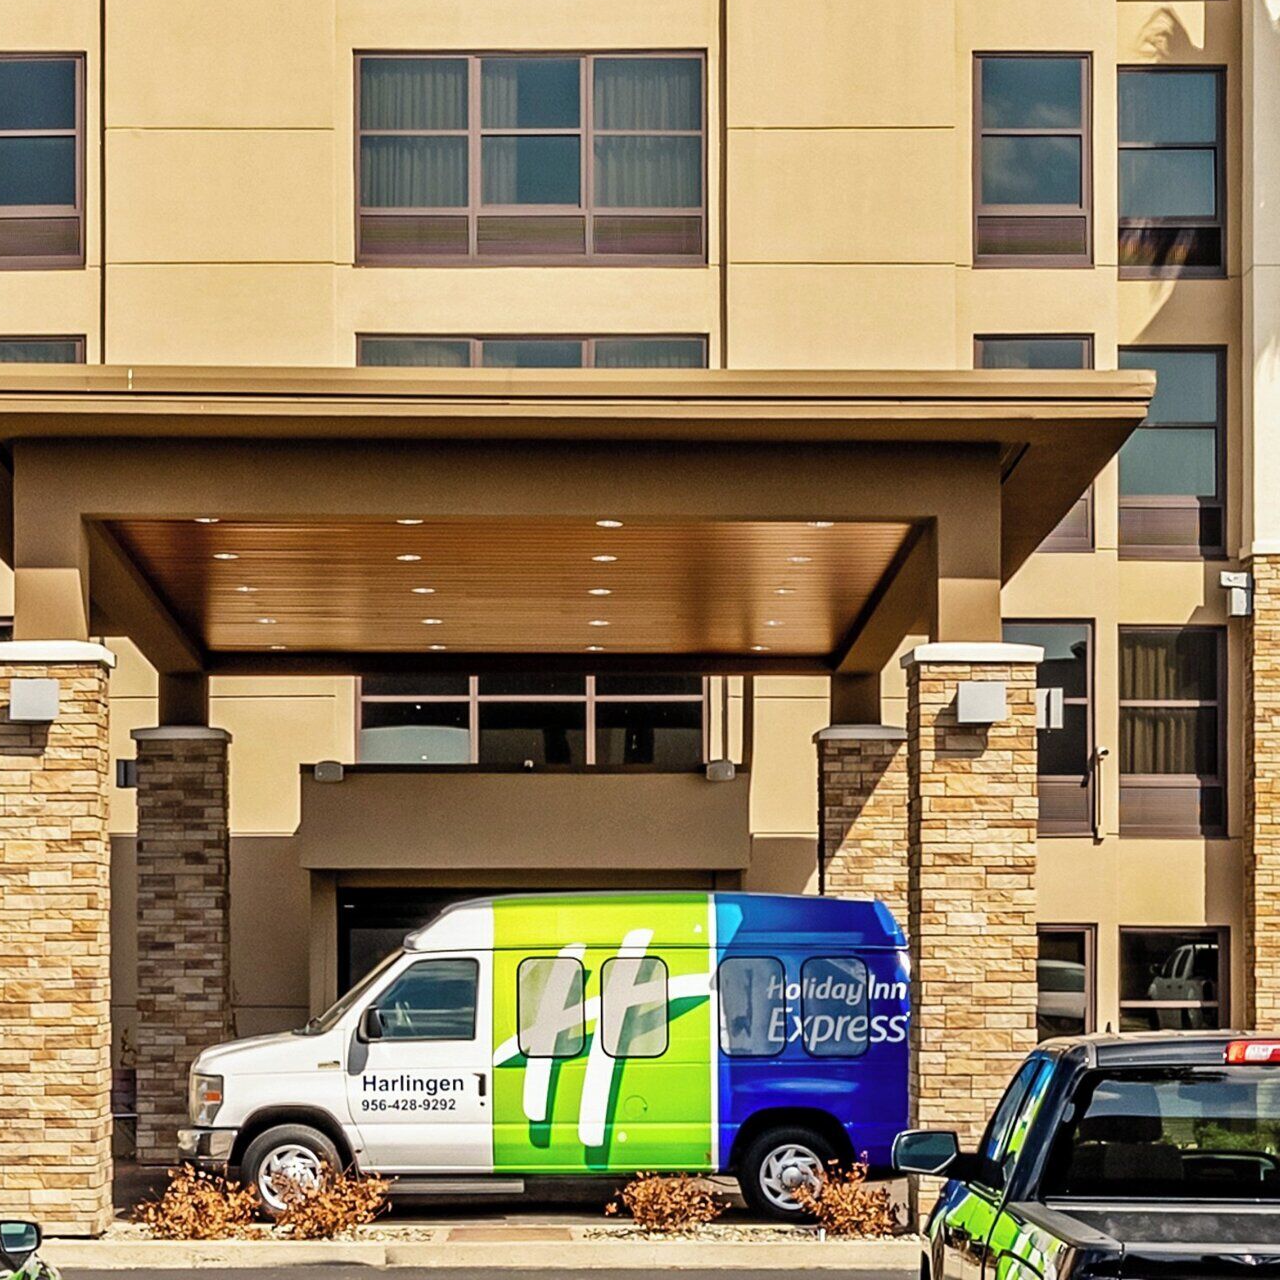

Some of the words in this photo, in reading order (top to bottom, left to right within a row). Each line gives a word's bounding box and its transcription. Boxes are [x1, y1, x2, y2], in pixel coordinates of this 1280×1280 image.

[767, 973, 863, 1006] Holiday
[868, 973, 907, 1000] Inn
[767, 1006, 908, 1052] Express
[362, 1074, 464, 1096] Harlingen
[361, 1099, 456, 1111] 956-428-9292
